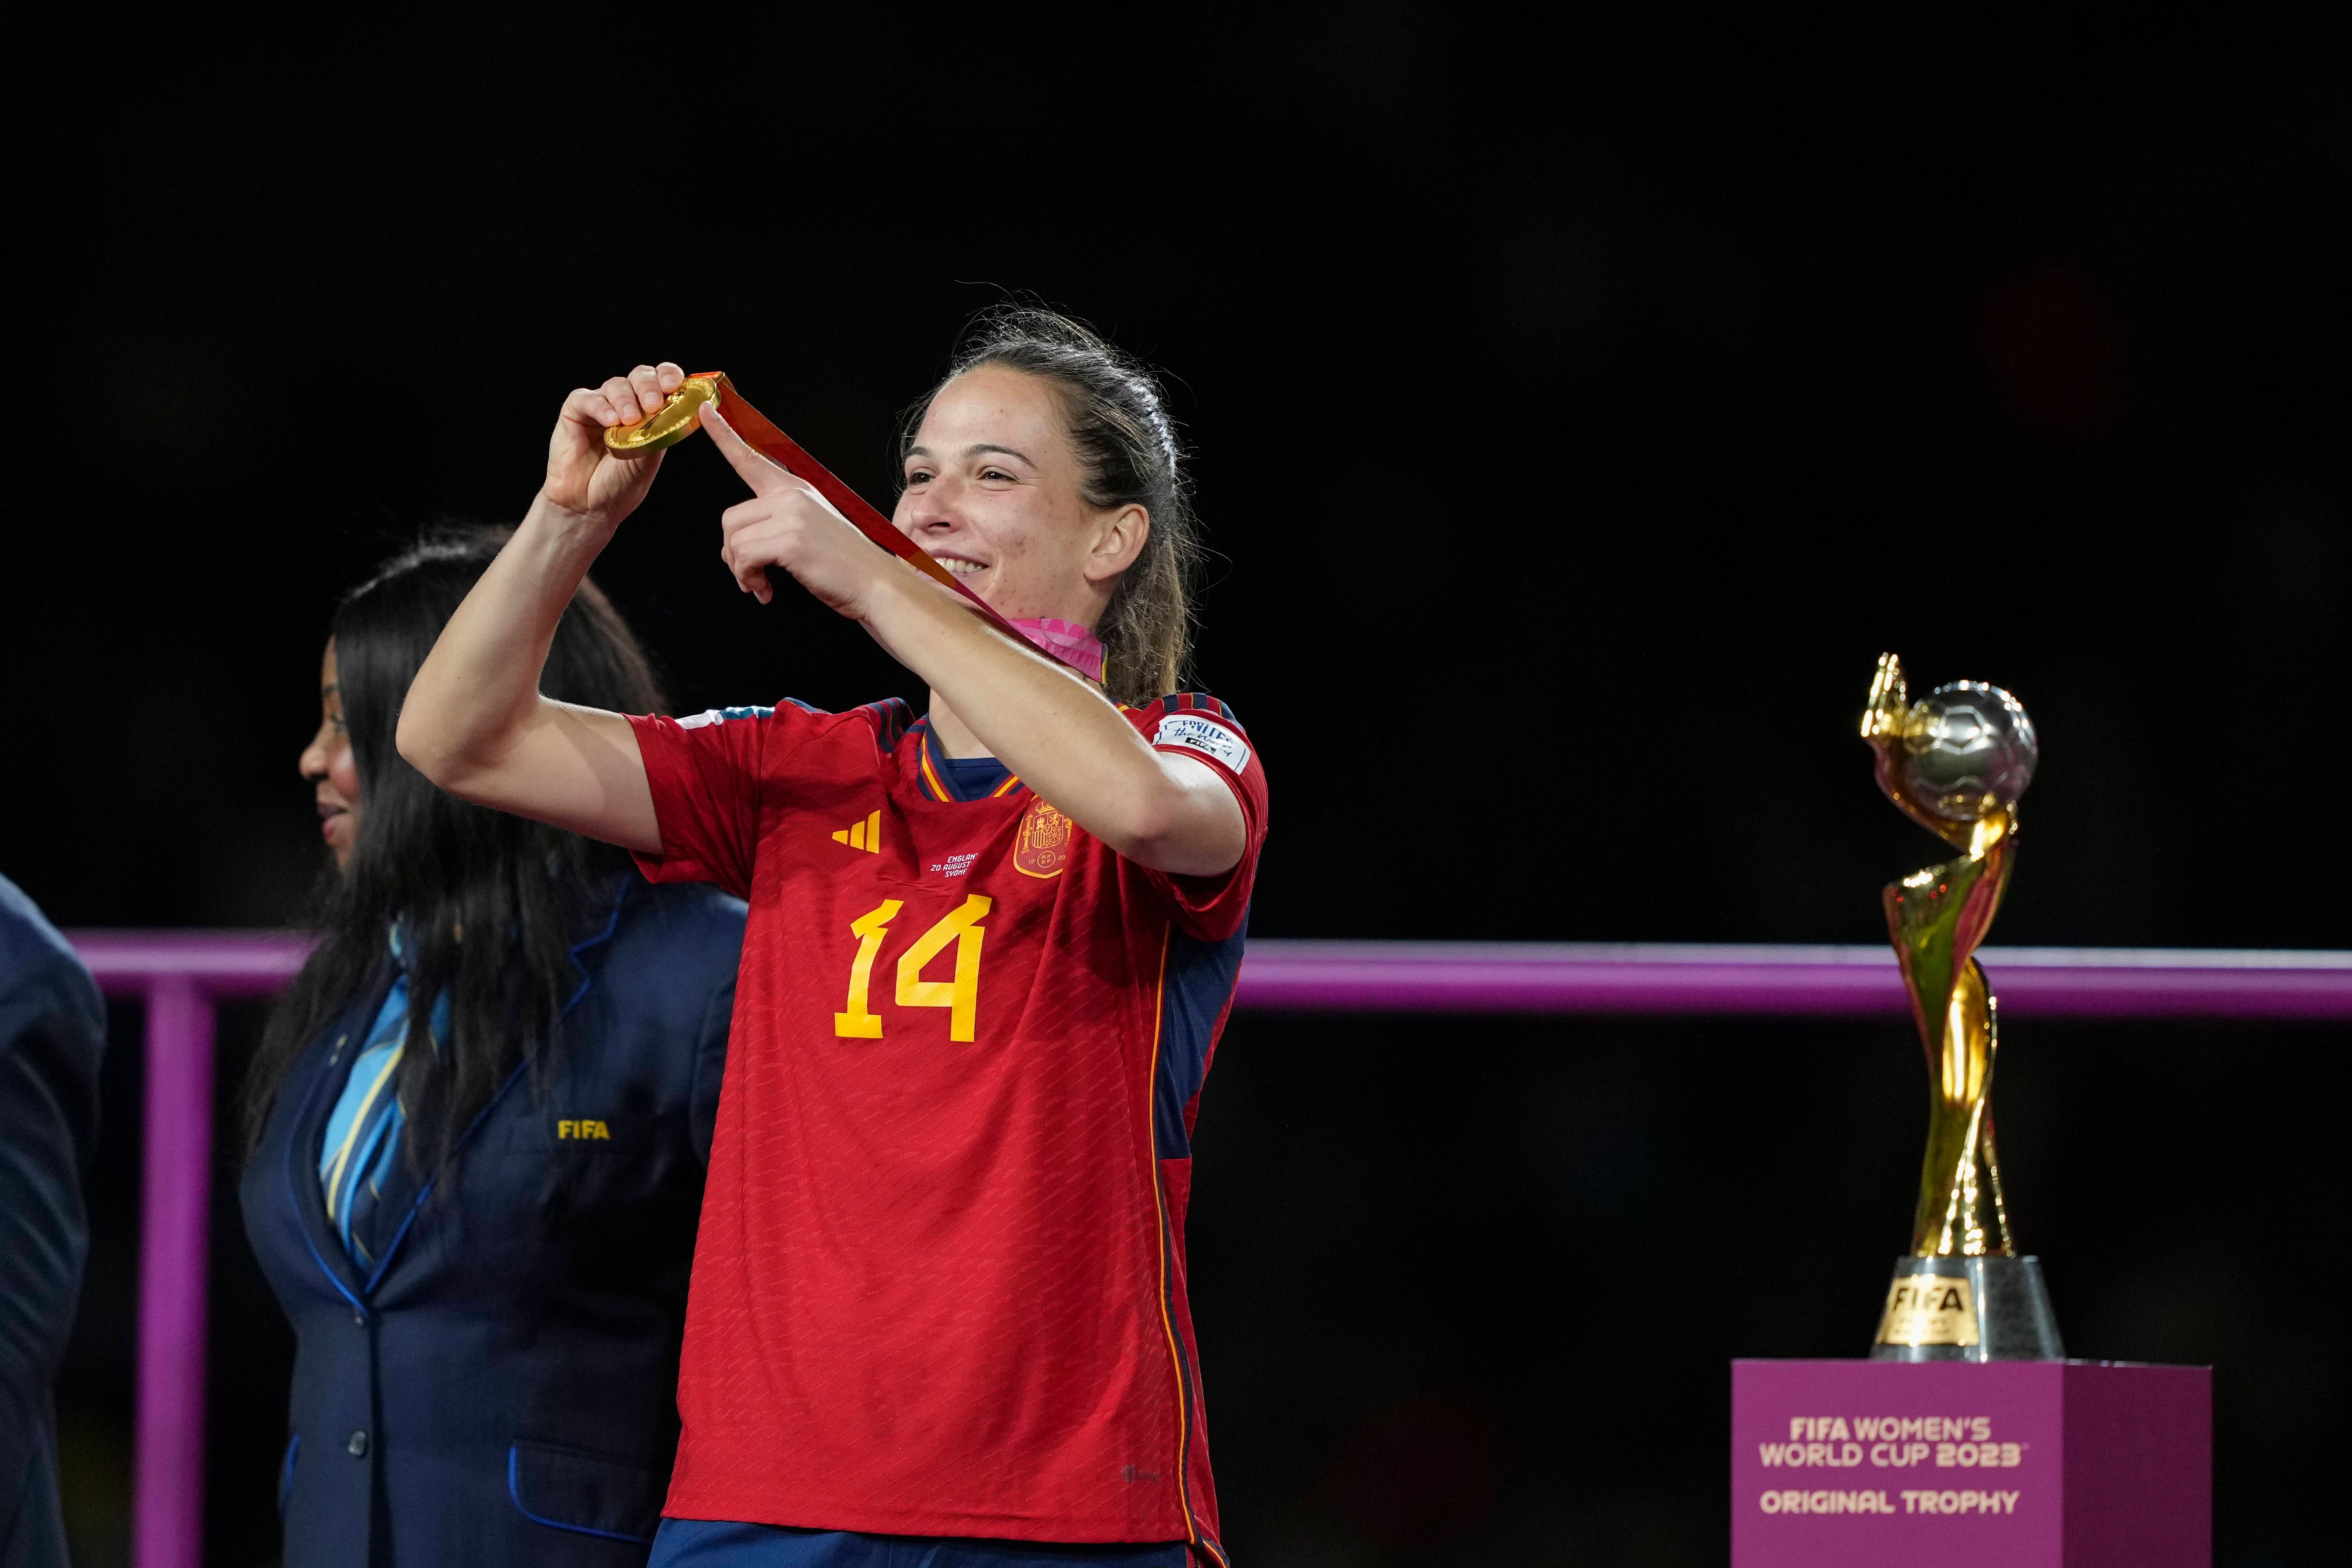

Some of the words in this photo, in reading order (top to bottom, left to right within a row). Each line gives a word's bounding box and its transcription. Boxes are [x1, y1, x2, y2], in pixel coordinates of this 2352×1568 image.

[1173, 727, 1195, 736] the
[1190, 739, 1212, 753] FIFA
[943, 861, 972, 871] AUGUST
[944, 868, 967, 877] SYDNE
[834, 894, 992, 1042] 14
[558, 1120, 610, 1140] FIFA
[1894, 1286, 1962, 1312] FIFA
[1790, 1417, 1850, 1441] FIFA
[1853, 1417, 1992, 1441] WOMEN'S
[1759, 1443, 1863, 1467] WORLD
[1870, 1443, 1930, 1467] CUP
[1935, 1442, 2021, 1467] 2023
[1759, 1491, 1896, 1515] ORIGINAL
[1900, 1491, 2020, 1515] TROPHY
